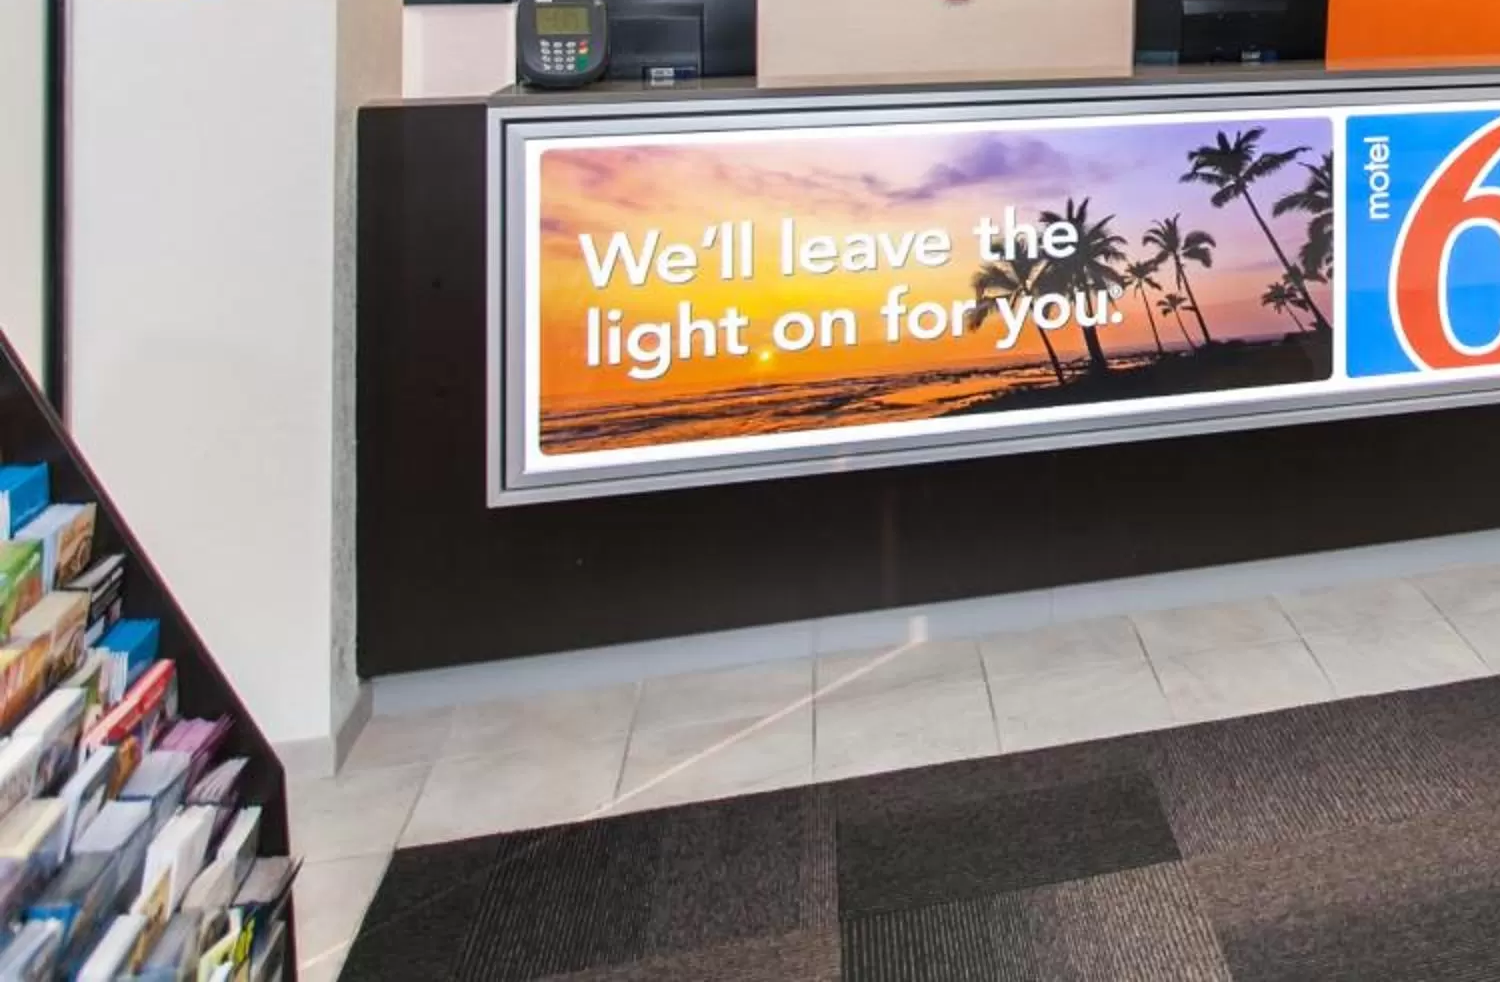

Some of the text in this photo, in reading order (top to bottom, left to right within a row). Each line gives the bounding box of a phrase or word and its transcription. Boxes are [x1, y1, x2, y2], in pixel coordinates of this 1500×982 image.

[1364, 136, 1390, 219] motel
[578, 206, 1079, 288] We'll leave the
[586, 301, 749, 379] light
[772, 305, 857, 351] on
[880, 285, 978, 341] for
